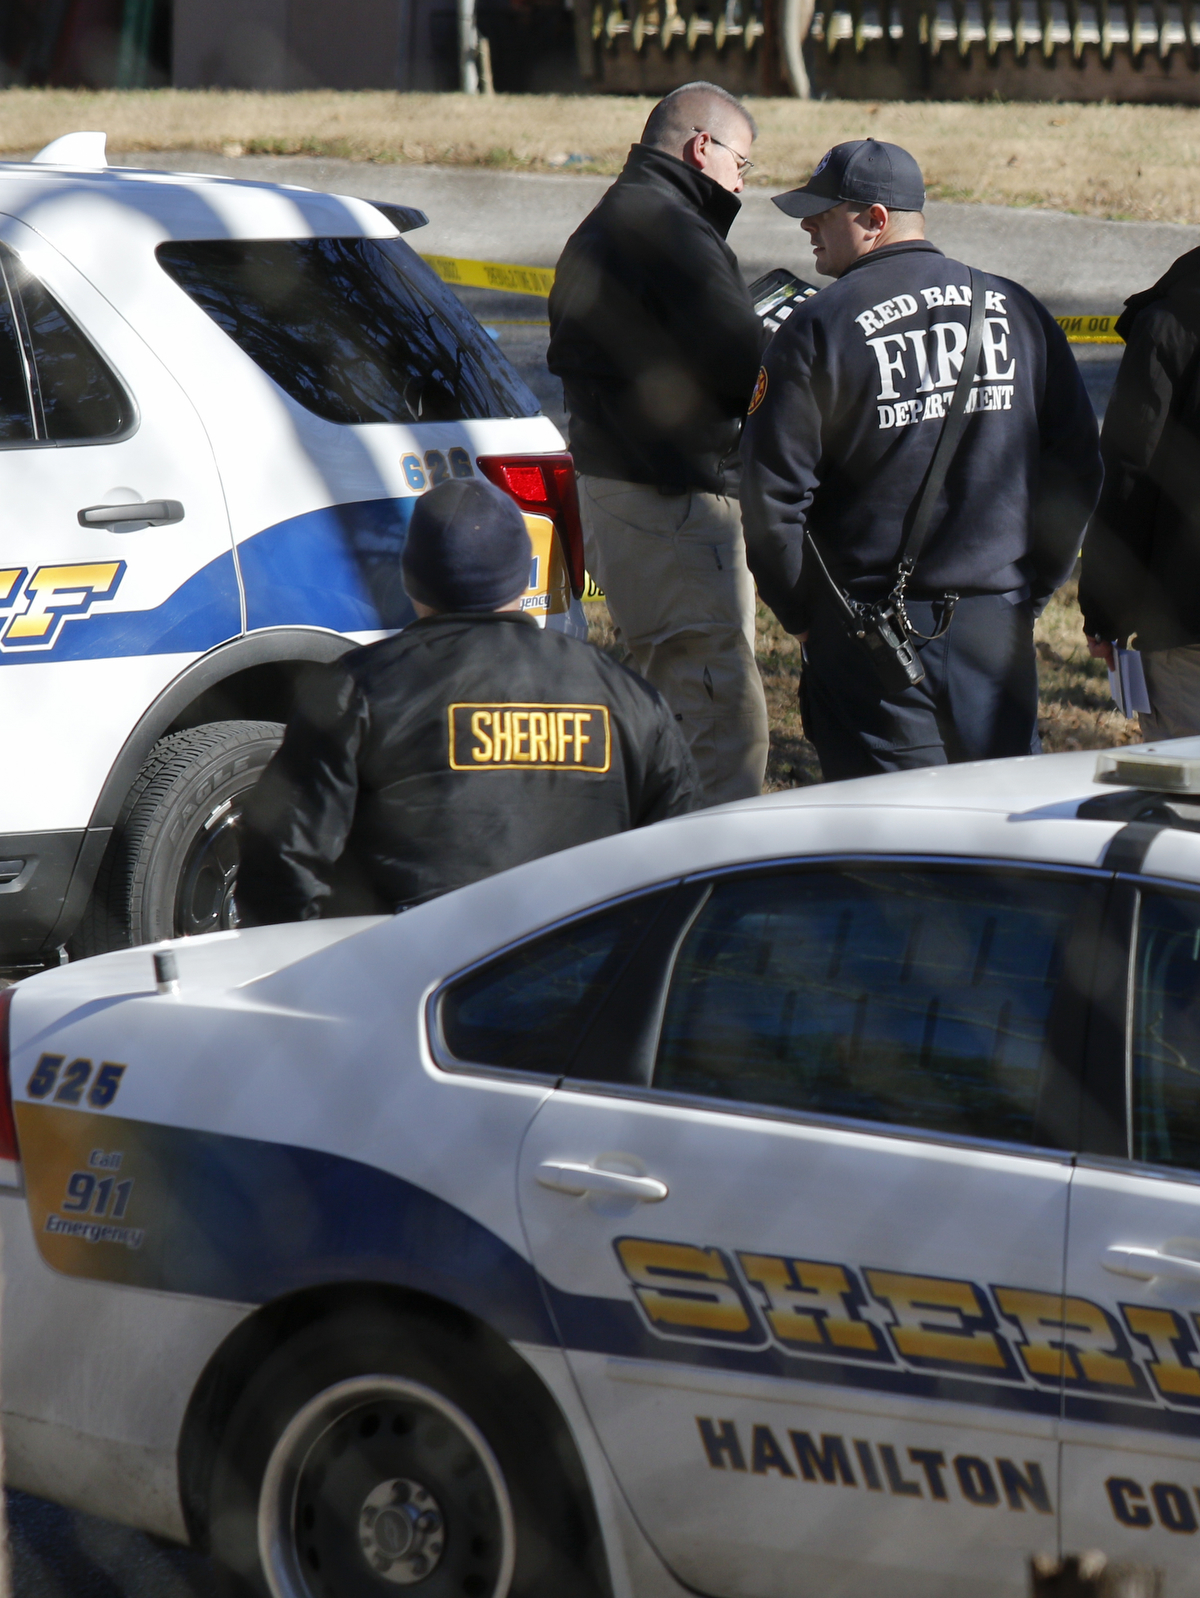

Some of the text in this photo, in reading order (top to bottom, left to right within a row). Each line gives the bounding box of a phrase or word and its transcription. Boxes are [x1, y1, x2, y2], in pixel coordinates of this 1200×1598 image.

[854, 294, 918, 337] RED
[865, 317, 1016, 401] FIRE
[471, 710, 592, 763] SHERIFF
[26, 1052, 128, 1110] 525
[87, 1148, 124, 1170] Call
[63, 1170, 135, 1218] 911
[45, 1213, 145, 1248] Emergency
[695, 1415, 1055, 1516] HAMILTON
